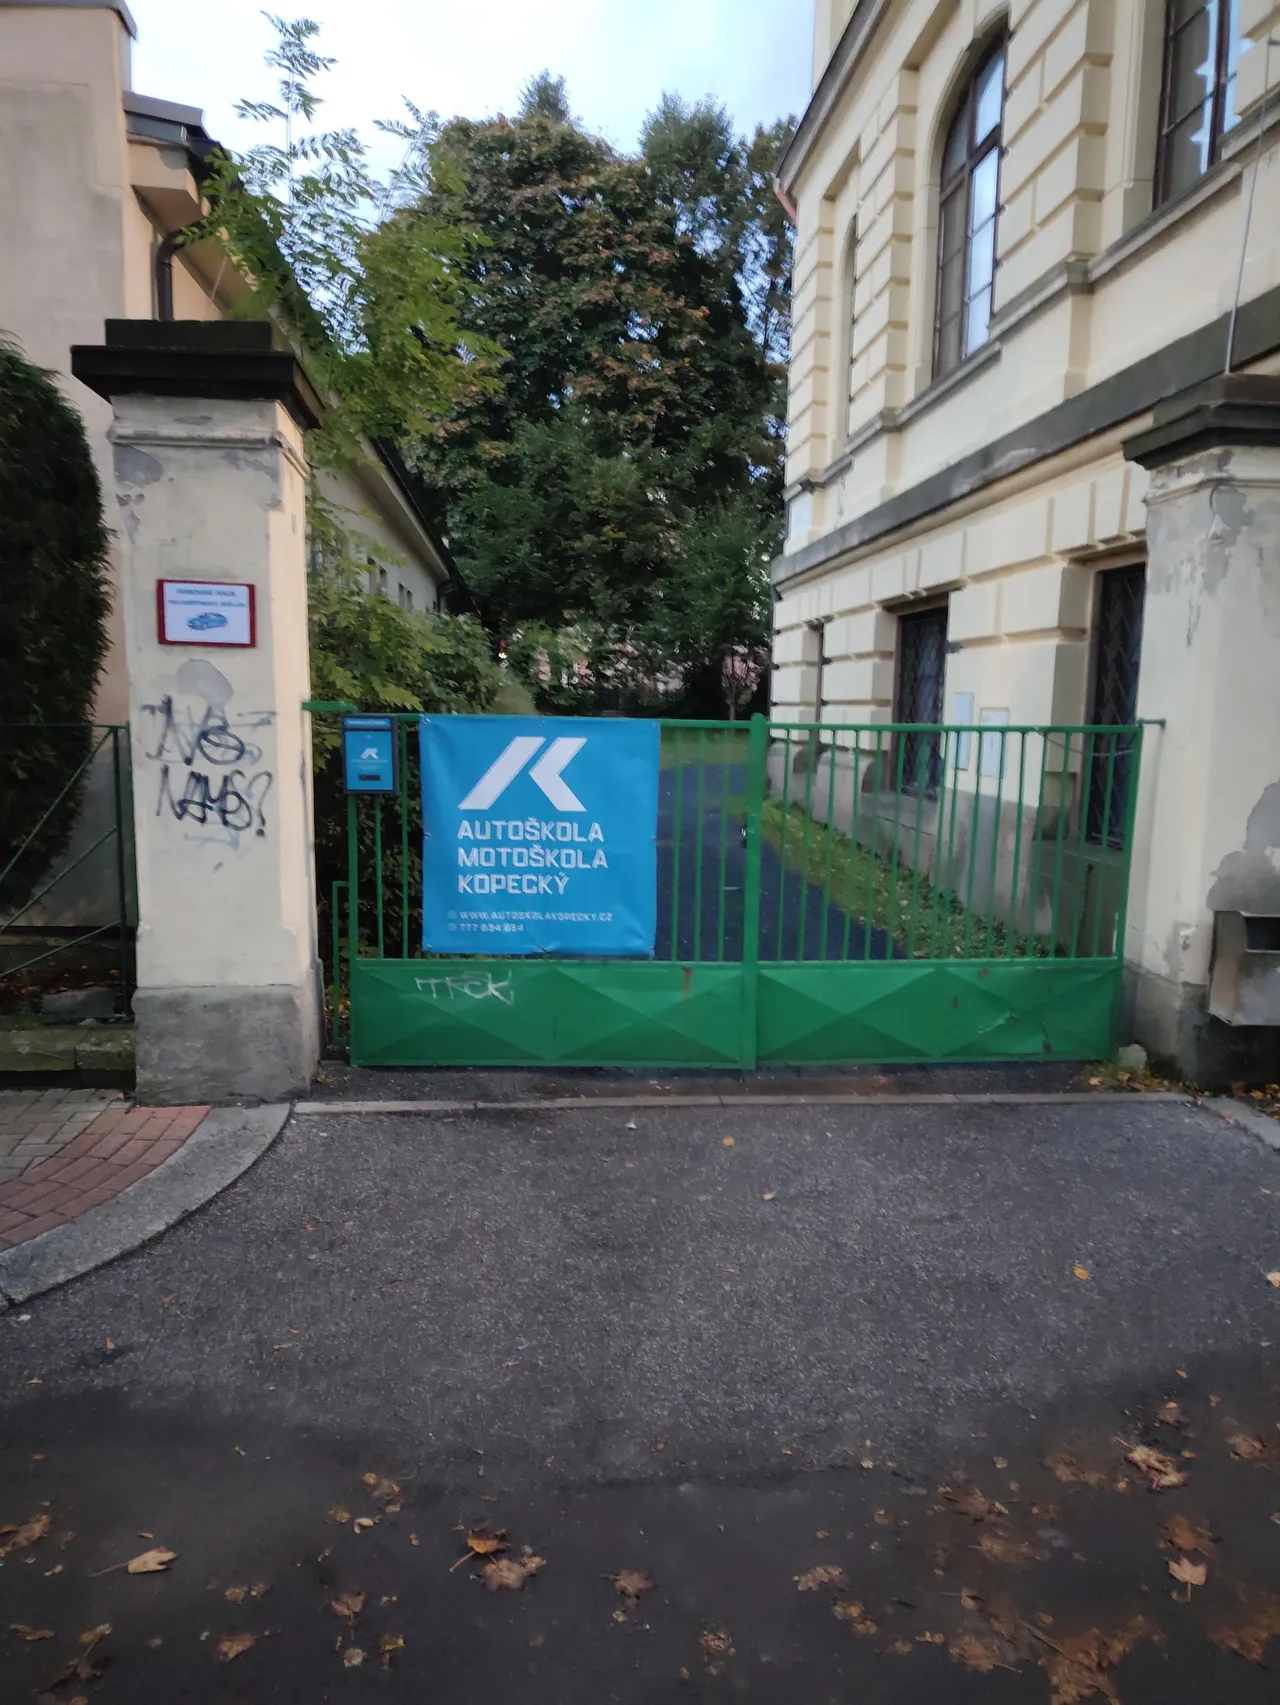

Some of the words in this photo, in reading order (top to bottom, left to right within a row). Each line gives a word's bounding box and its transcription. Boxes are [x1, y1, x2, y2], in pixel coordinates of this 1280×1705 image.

[457, 817, 605, 843] AUTOŠKOLA
[457, 844, 609, 869] MOTOŠKOLA
[458, 872, 570, 895] KOPECKÝ
